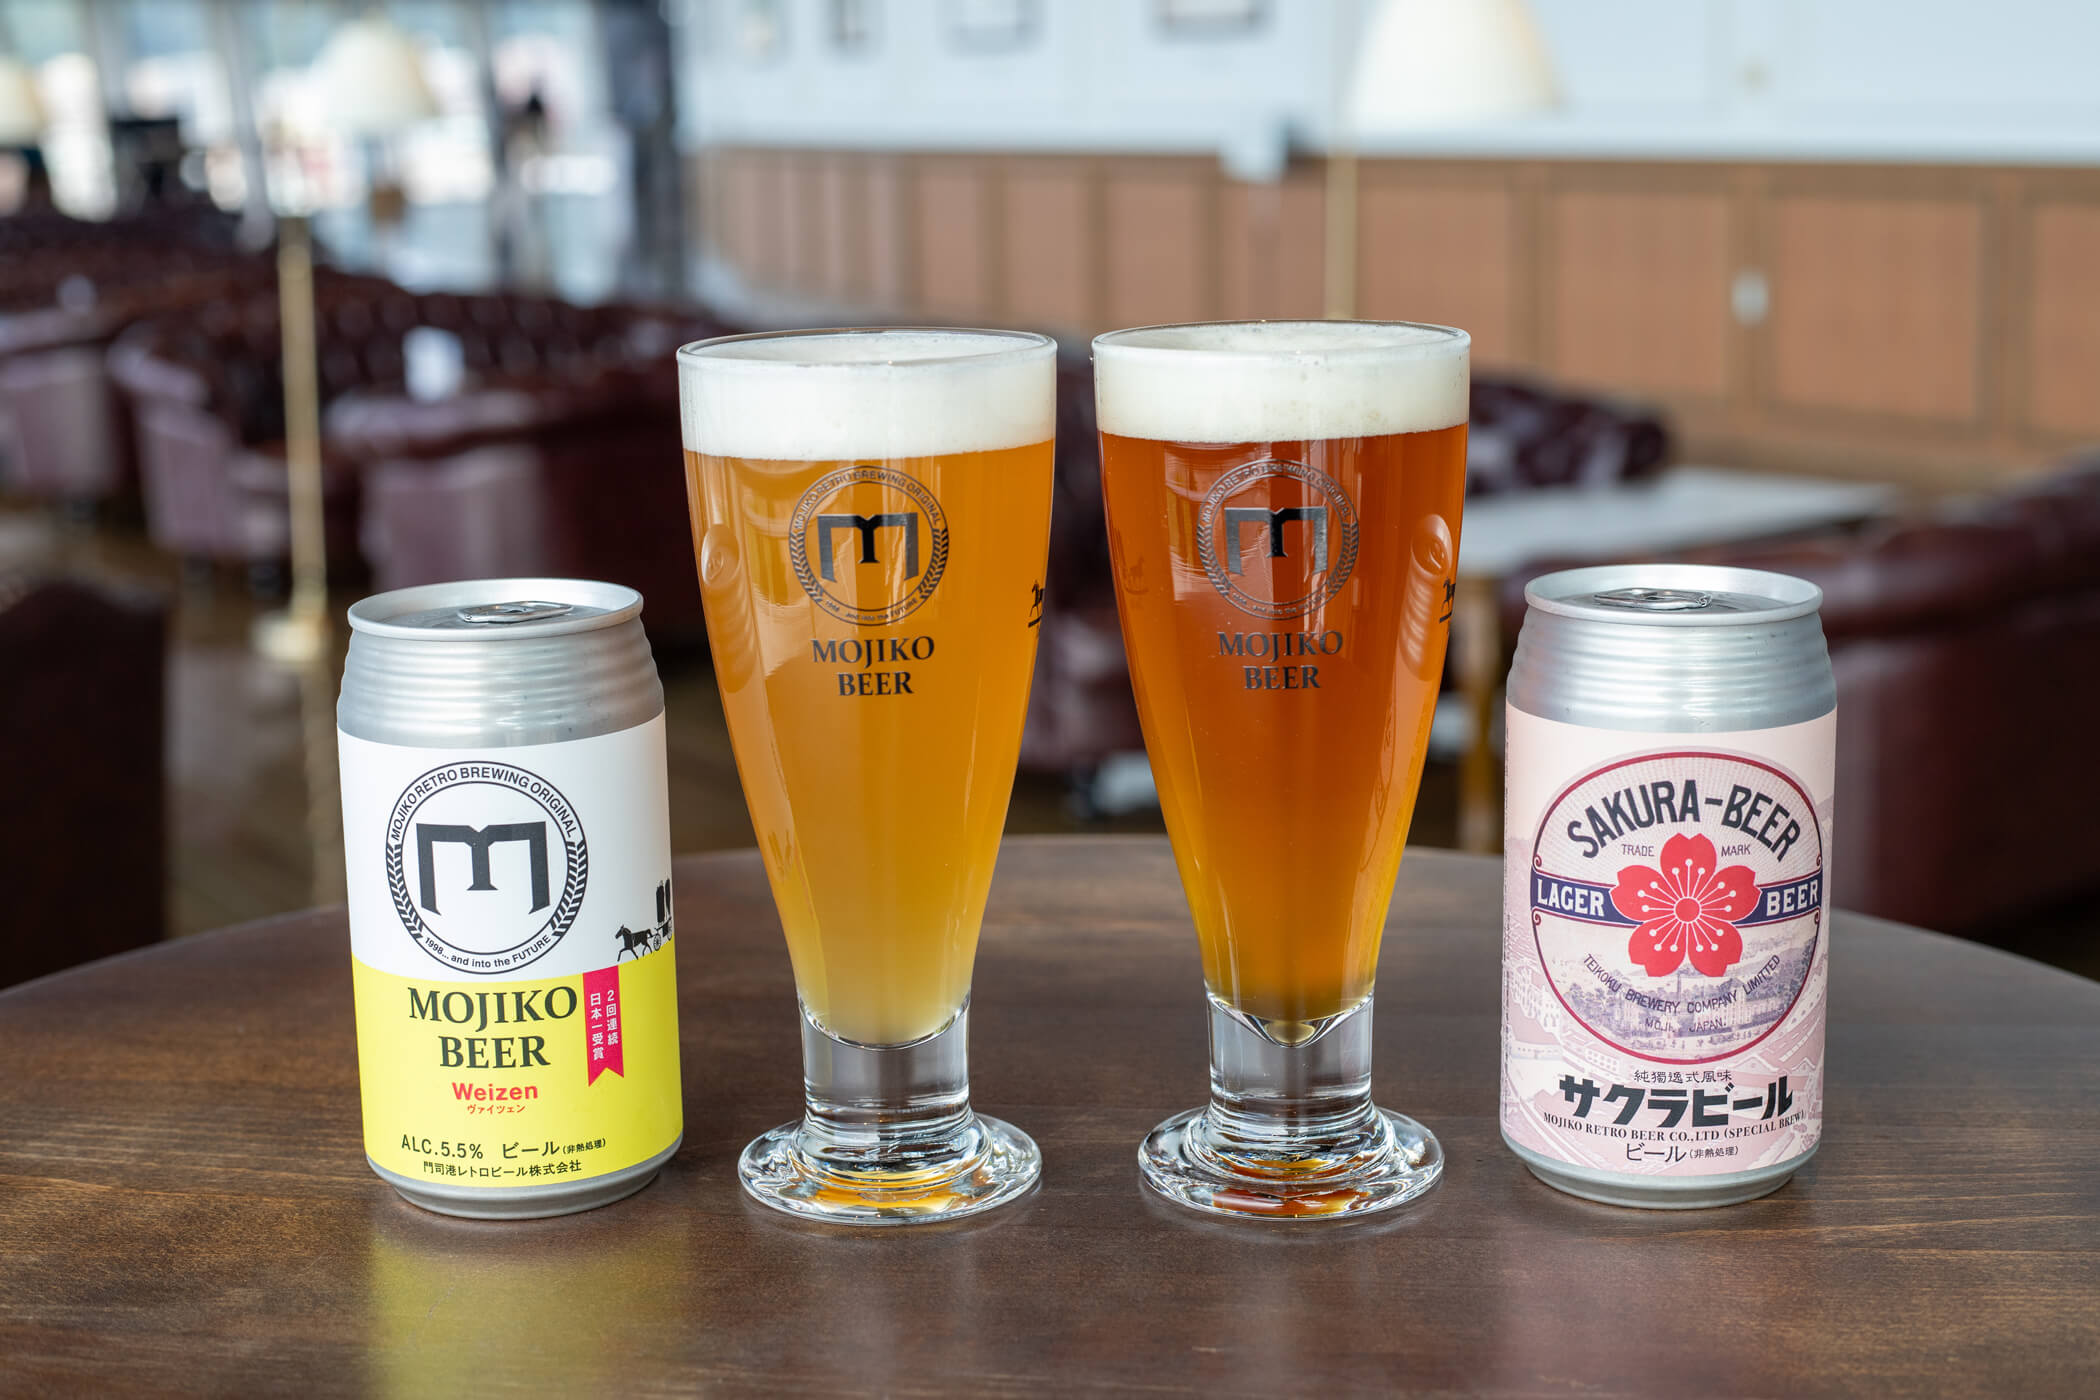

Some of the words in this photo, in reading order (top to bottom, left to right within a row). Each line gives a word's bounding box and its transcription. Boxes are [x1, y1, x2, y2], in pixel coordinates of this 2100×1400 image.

[853, 469, 906, 488] BREWING
[810, 635, 935, 669] MOJIKO
[1216, 630, 1343, 663] MOJIKO
[836, 671, 915, 696] BEER
[1242, 665, 1321, 690] BEER
[391, 793, 417, 840] MOJIKO
[414, 769, 458, 798] RETRO
[460, 766, 530, 788] BREWING
[530, 782, 578, 838] ORIGINAL
[1621, 844, 1655, 857] TRADE
[1721, 844, 1751, 857] MARK
[1537, 879, 1605, 917] LAGER
[1766, 879, 1820, 917] BEER
[451, 953, 469, 967] and
[471, 958, 491, 969] into
[494, 956, 511, 967] the
[511, 934, 552, 964] FUTURE
[1583, 953, 1622, 993] TEIKOKU
[1625, 989, 1680, 1014] BREWERY
[1687, 990, 1738, 1014] COMPANY
[407, 985, 578, 1032] MOJIKO
[590, 992, 605, 1061] 日本一受賞
[438, 1035, 551, 1069] BEER
[452, 1081, 539, 1101] Weizen
[1559, 1074, 1793, 1128] サクラビール
[466, 1104, 526, 1115] ヴァイツェン
[1543, 1112, 1582, 1131] MOJIKO
[1586, 1123, 1627, 1138] RETRO
[1631, 1130, 1665, 1142] BEER
[1724, 1120, 1777, 1139] (SPECIAL
[423, 1160, 582, 1178] 門司港レトロビール株式会社
